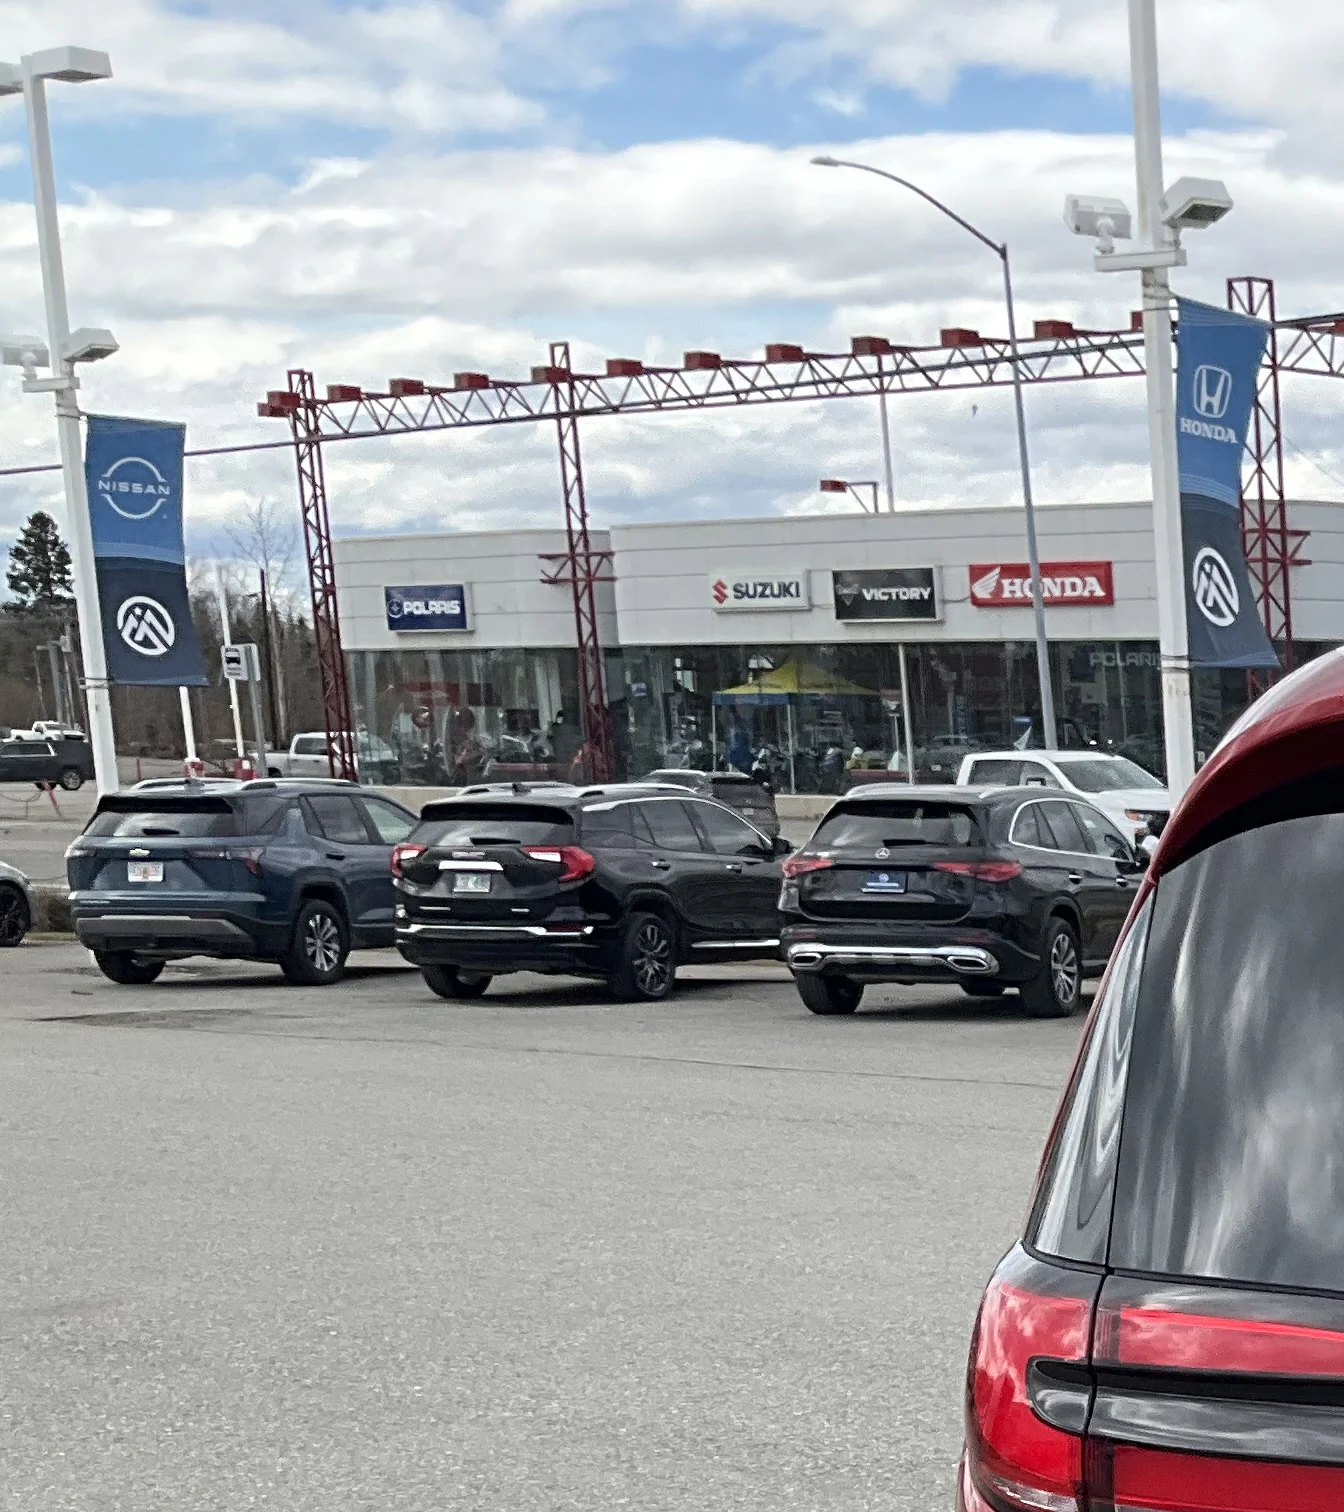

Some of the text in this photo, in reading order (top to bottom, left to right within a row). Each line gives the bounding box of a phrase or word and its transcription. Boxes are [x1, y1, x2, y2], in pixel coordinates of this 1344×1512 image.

[1180, 417, 1238, 444] HONDA
[98, 480, 170, 495] NISSAN
[733, 581, 801, 600] SUZUKI
[862, 586, 932, 601] VICTORY
[403, 600, 461, 615] POLARIS
